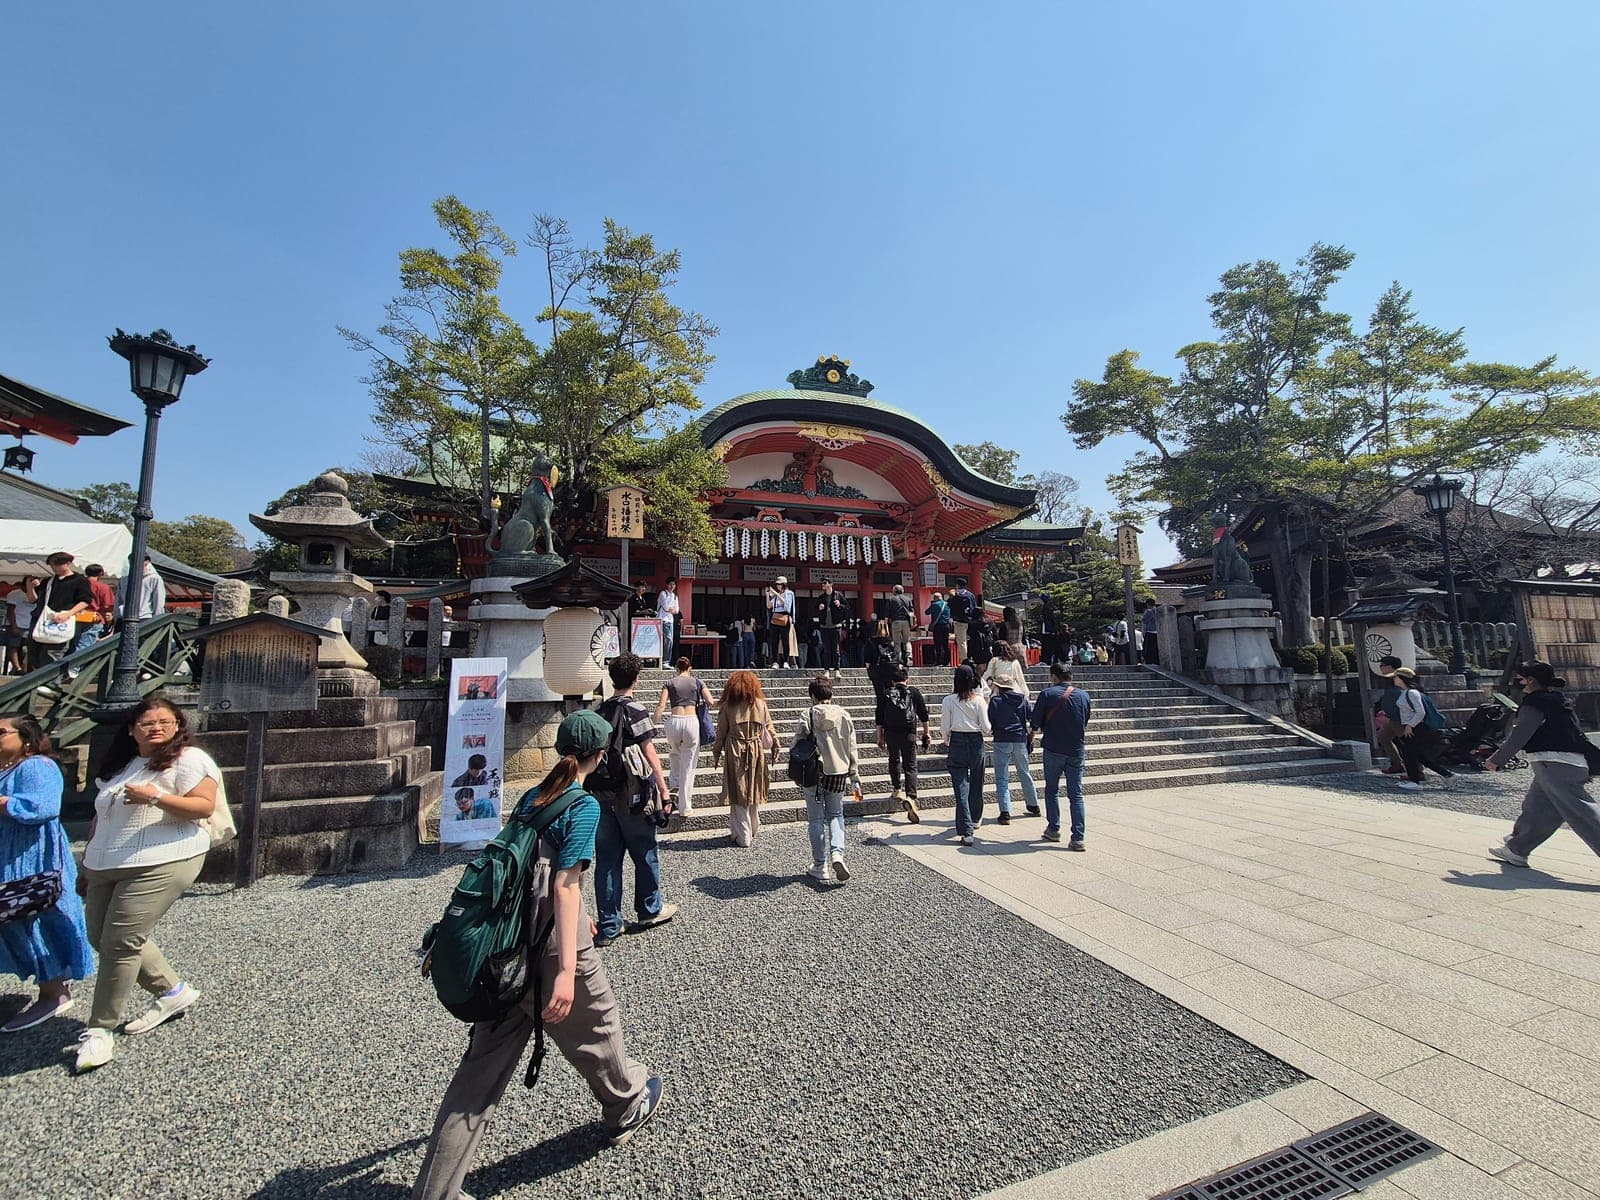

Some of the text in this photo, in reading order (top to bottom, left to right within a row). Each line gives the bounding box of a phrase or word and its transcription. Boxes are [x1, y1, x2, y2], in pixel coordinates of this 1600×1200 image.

[620, 491, 632, 534] 水口播種祭
